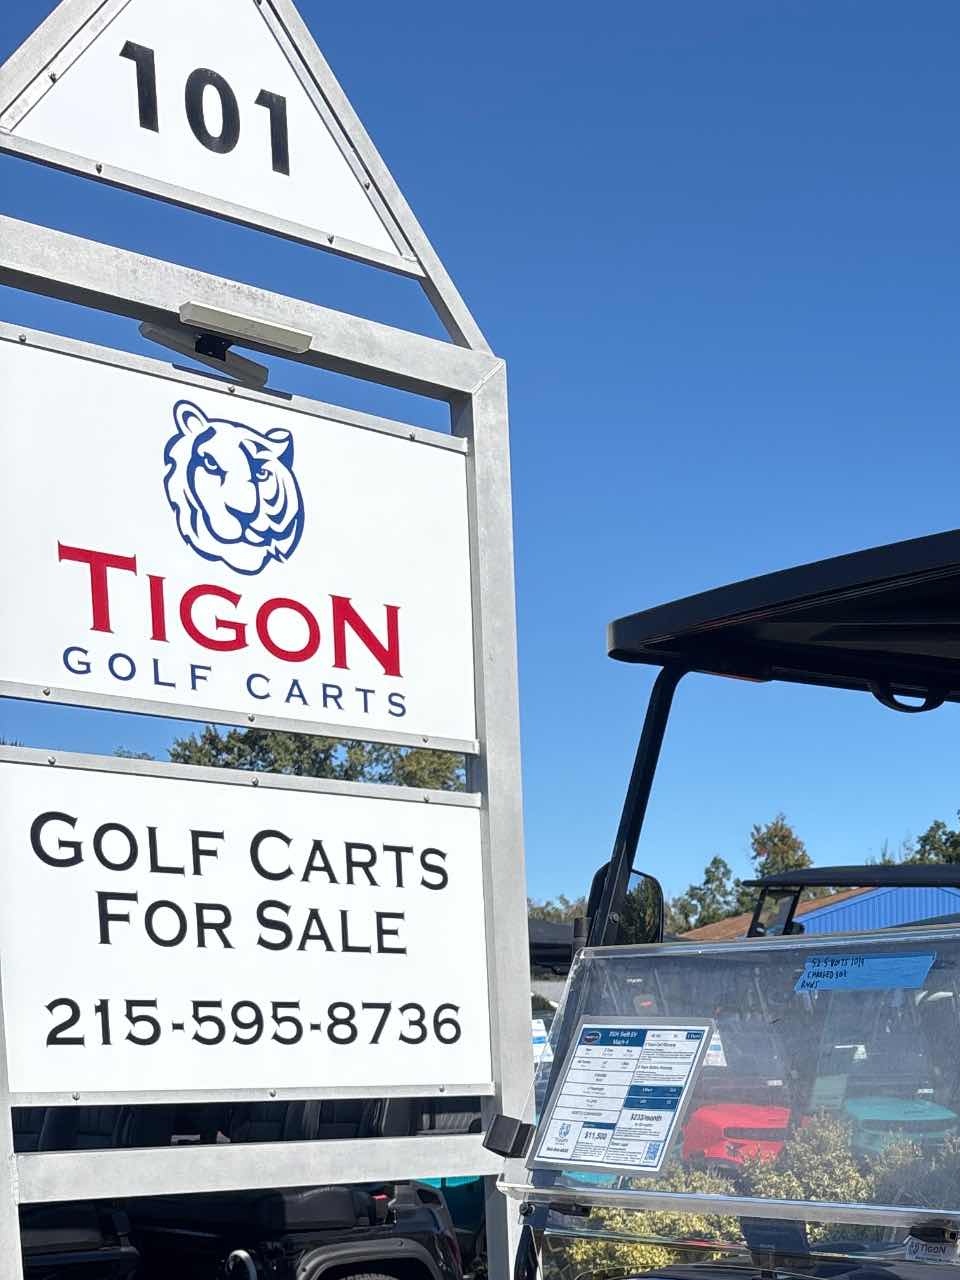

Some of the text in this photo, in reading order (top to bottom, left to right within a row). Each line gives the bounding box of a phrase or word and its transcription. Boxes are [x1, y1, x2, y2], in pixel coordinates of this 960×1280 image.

[119, 40, 290, 177] 101
[58, 542, 403, 678] TIGON
[62, 646, 407, 718] GOLF CARTS
[30, 811, 449, 891] GOLF CARTS
[97, 890, 407, 955] FOR SALE
[45, 997, 462, 1047] 215-595-8736
